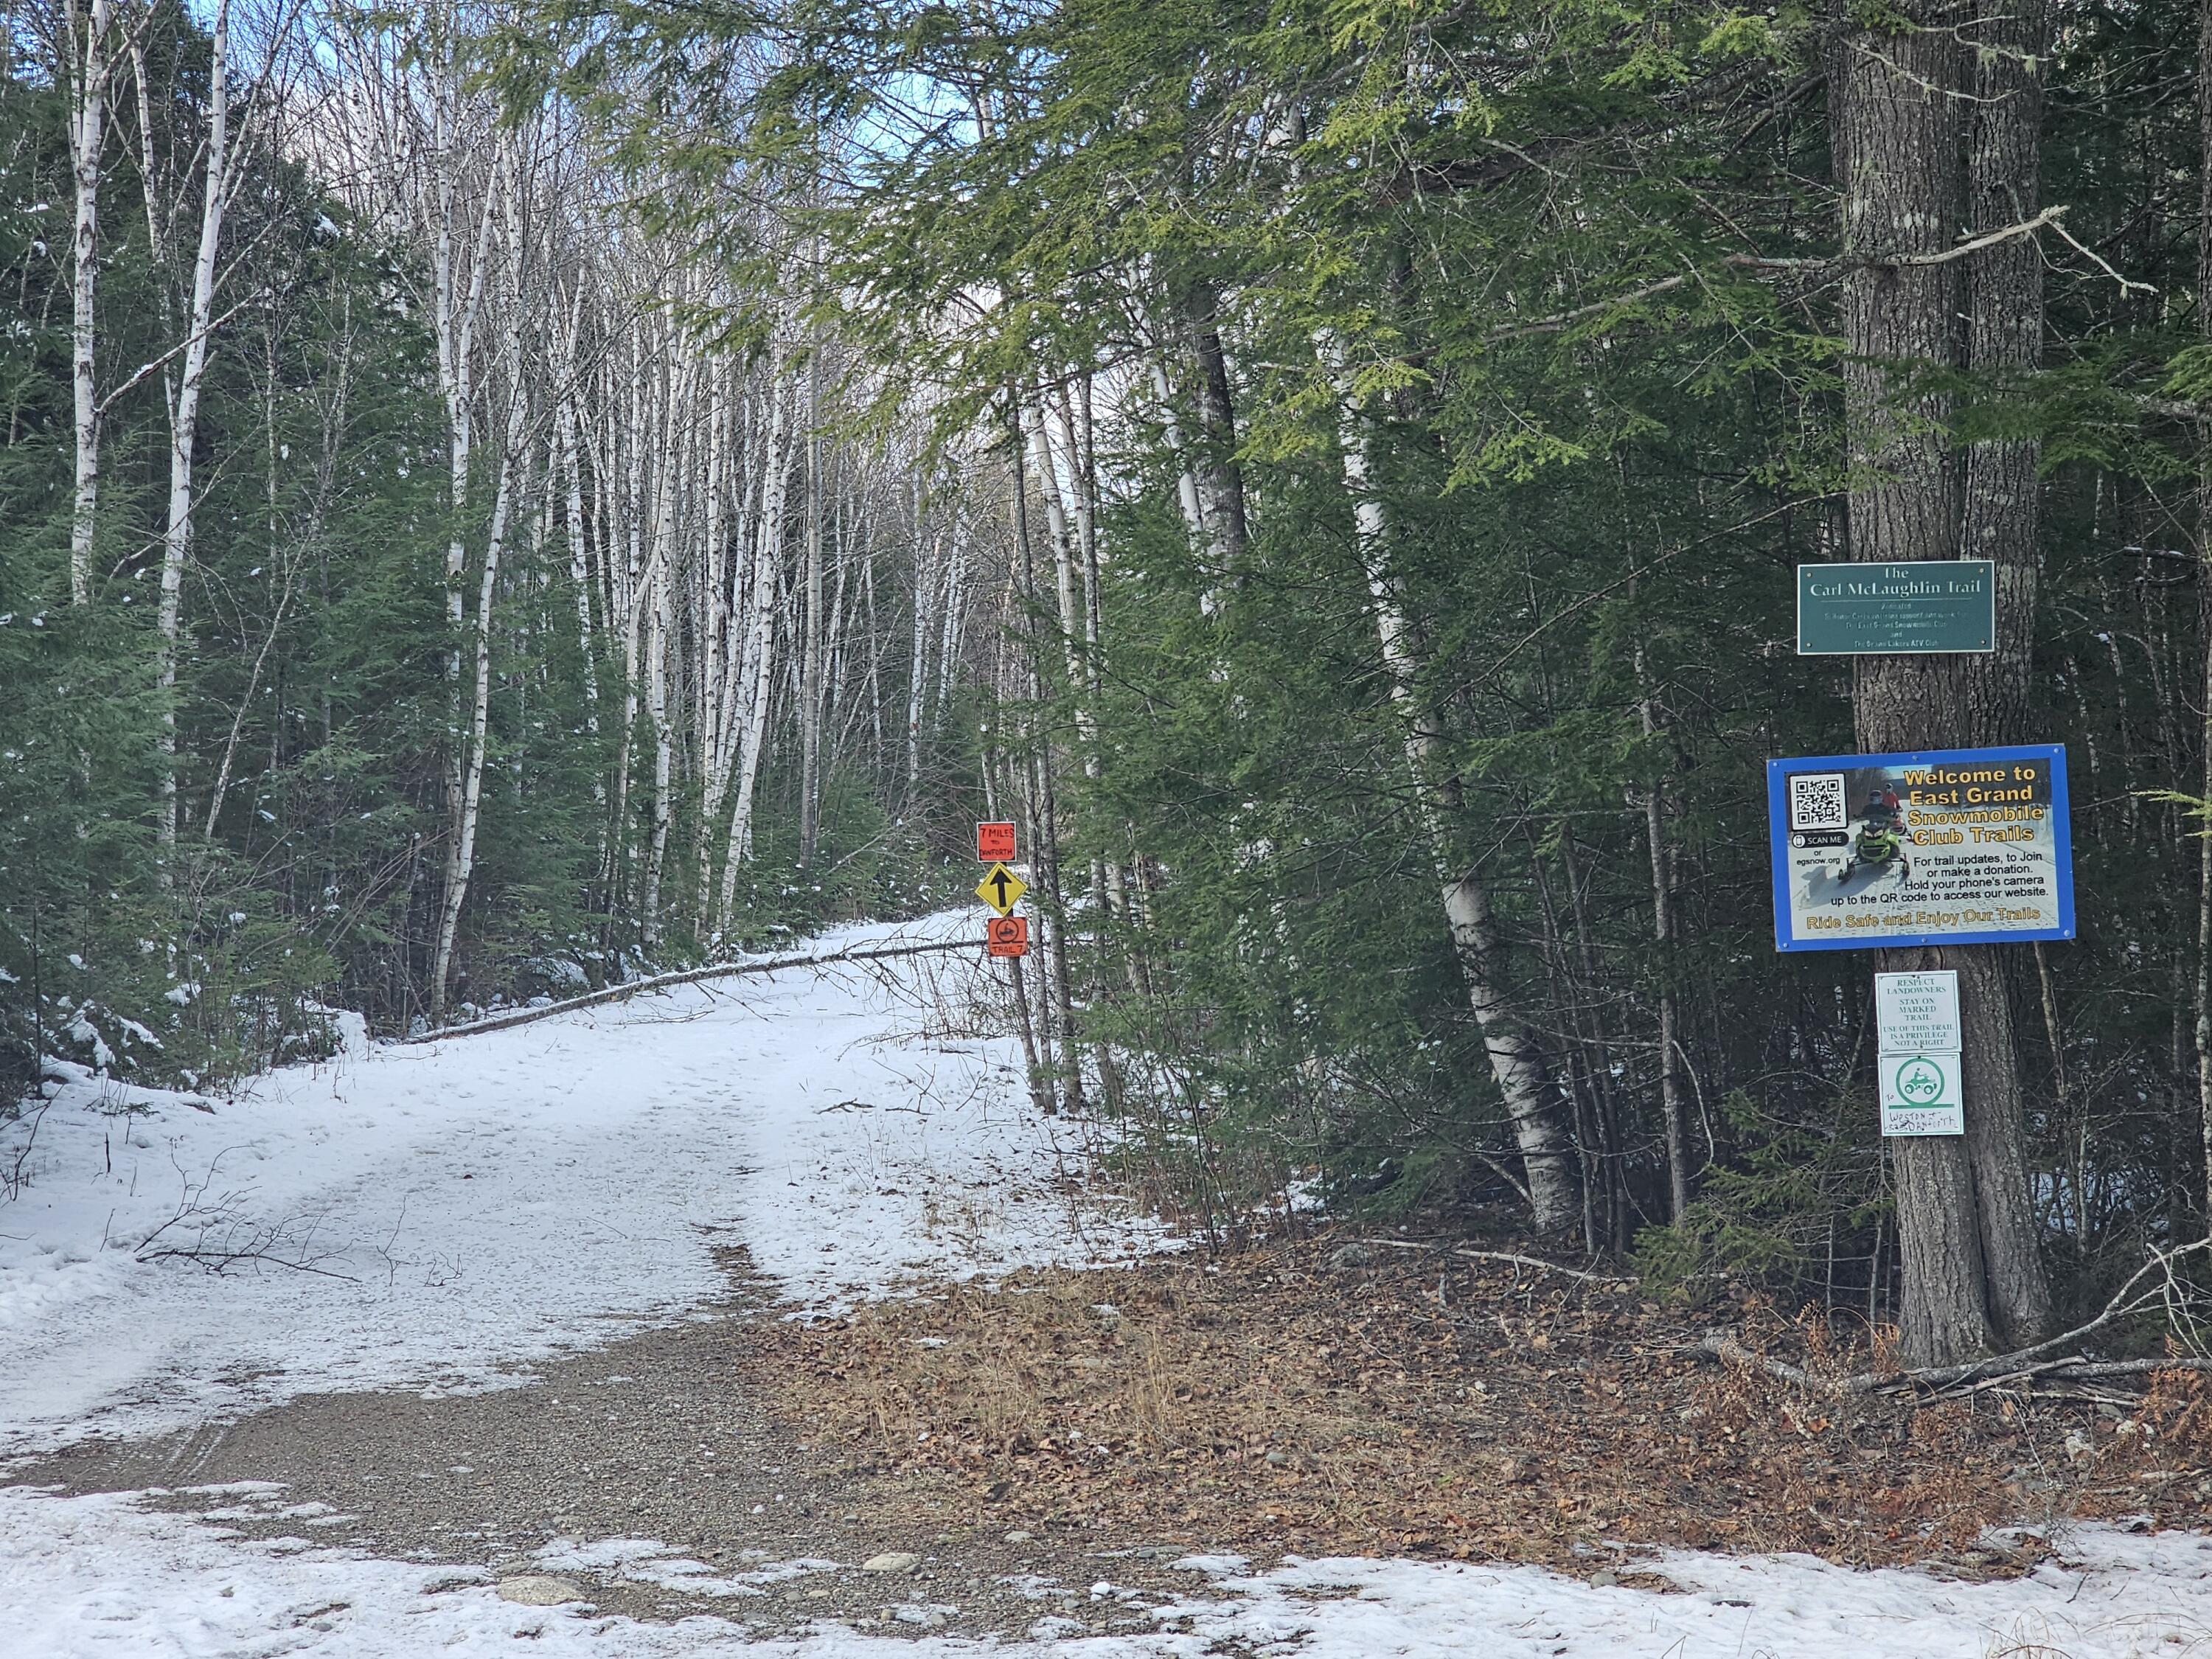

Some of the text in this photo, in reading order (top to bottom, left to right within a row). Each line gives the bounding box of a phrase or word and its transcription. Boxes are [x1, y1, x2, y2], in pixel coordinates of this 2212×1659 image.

[1885, 568, 1909, 579] The
[1810, 580, 1980, 597] Carl McLaughlin Trail
[1904, 766, 2036, 786] Welcome to
[1910, 785, 2032, 806] East Grand
[1908, 807, 2044, 826] Snowmobile
[980, 829, 1014, 838] 7 MILES
[1808, 835, 1842, 844] SCAN ME
[1913, 825, 2035, 846] Club Trails
[1796, 857, 1840, 866] egsnow.org
[1914, 852, 2042, 866] For trail updates, to Join
[1941, 867, 1971, 877] make
[1974, 867, 1980, 875] a
[1983, 864, 2033, 874] donation.
[1905, 876, 2044, 891] Hold your phone's camera
[1831, 898, 1844, 907] up
[1847, 896, 1857, 905] to
[1860, 894, 1877, 904] the
[1880, 894, 1898, 902] QR
[1902, 892, 1927, 902] code
[1930, 891, 1941, 901] to
[1944, 890, 1981, 900] access
[2005, 887, 2049, 897] website.
[1806, 906, 2040, 929] Ride Safe and Enjoy Our Trails
